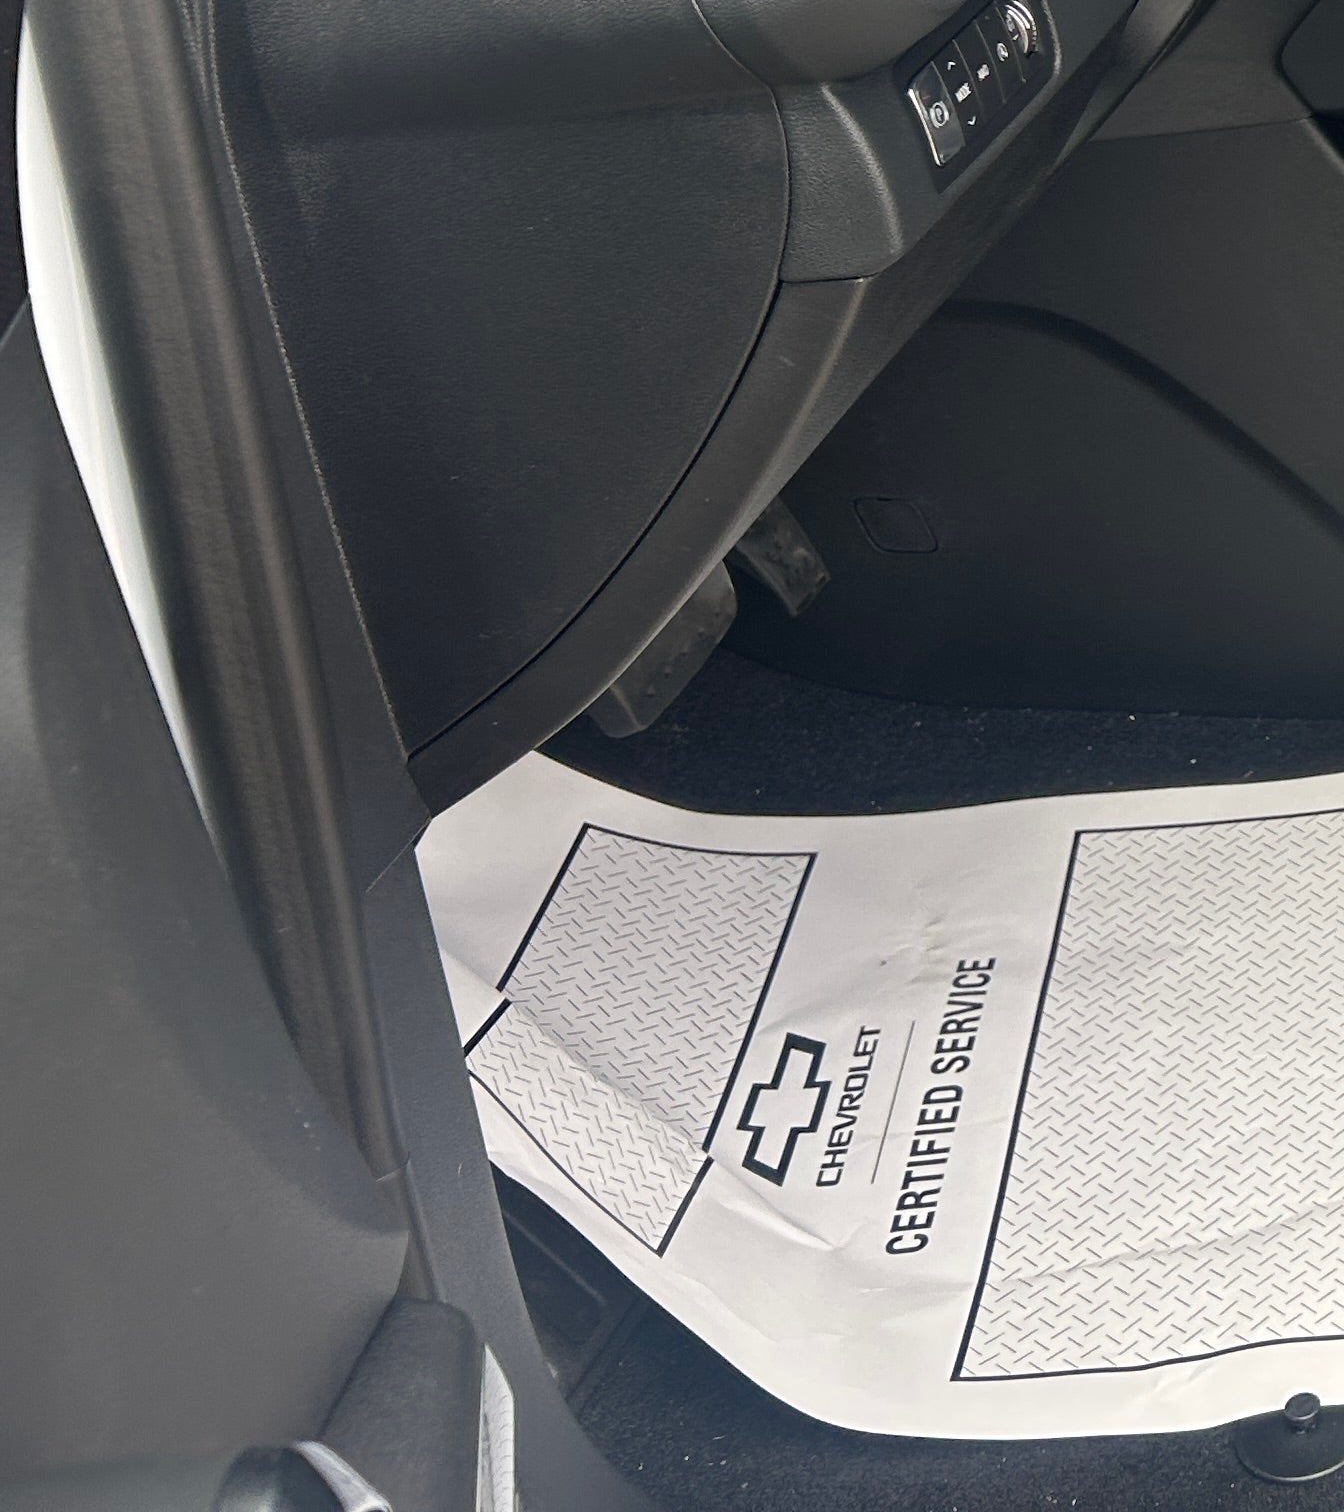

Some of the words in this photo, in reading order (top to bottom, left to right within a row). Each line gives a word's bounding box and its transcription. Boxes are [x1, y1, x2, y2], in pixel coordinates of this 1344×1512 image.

[816, 1025, 881, 1187] CHEVROLET
[885, 1084, 964, 1255] CERTIFIED
[930, 957, 997, 1075] SERVICE
